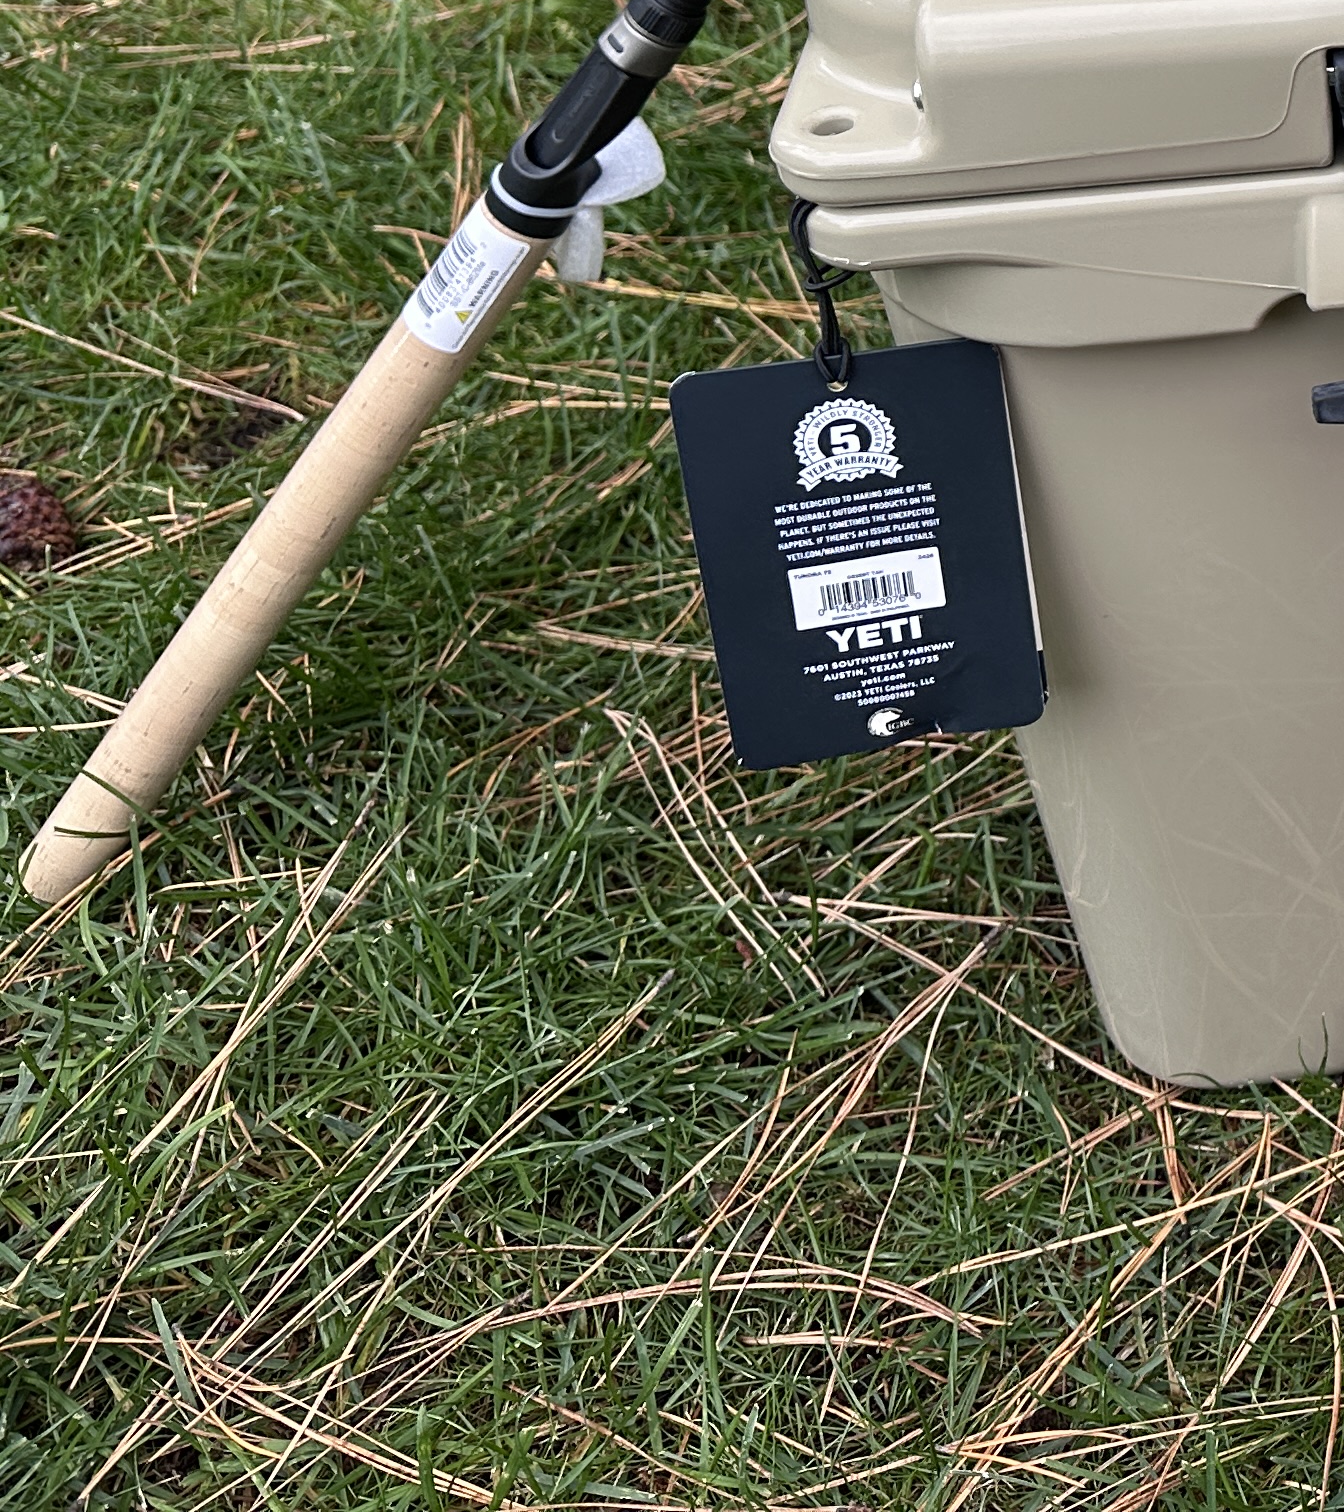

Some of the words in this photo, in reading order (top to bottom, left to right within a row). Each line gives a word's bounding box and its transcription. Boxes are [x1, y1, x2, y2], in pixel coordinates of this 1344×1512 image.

[813, 410, 848, 428] WILDLY
[830, 424, 861, 455] 5
[806, 462, 832, 478] YEAR
[834, 456, 891, 467] WARRANTY
[826, 615, 922, 652] YETI
[803, 664, 828, 674] 7601
[832, 652, 900, 670] SOUTHWEST
[902, 641, 954, 657] PARKWAY
[823, 668, 867, 682] AUSTIN,
[870, 662, 905, 673] TEXAS
[920, 676, 935, 686] LLC
